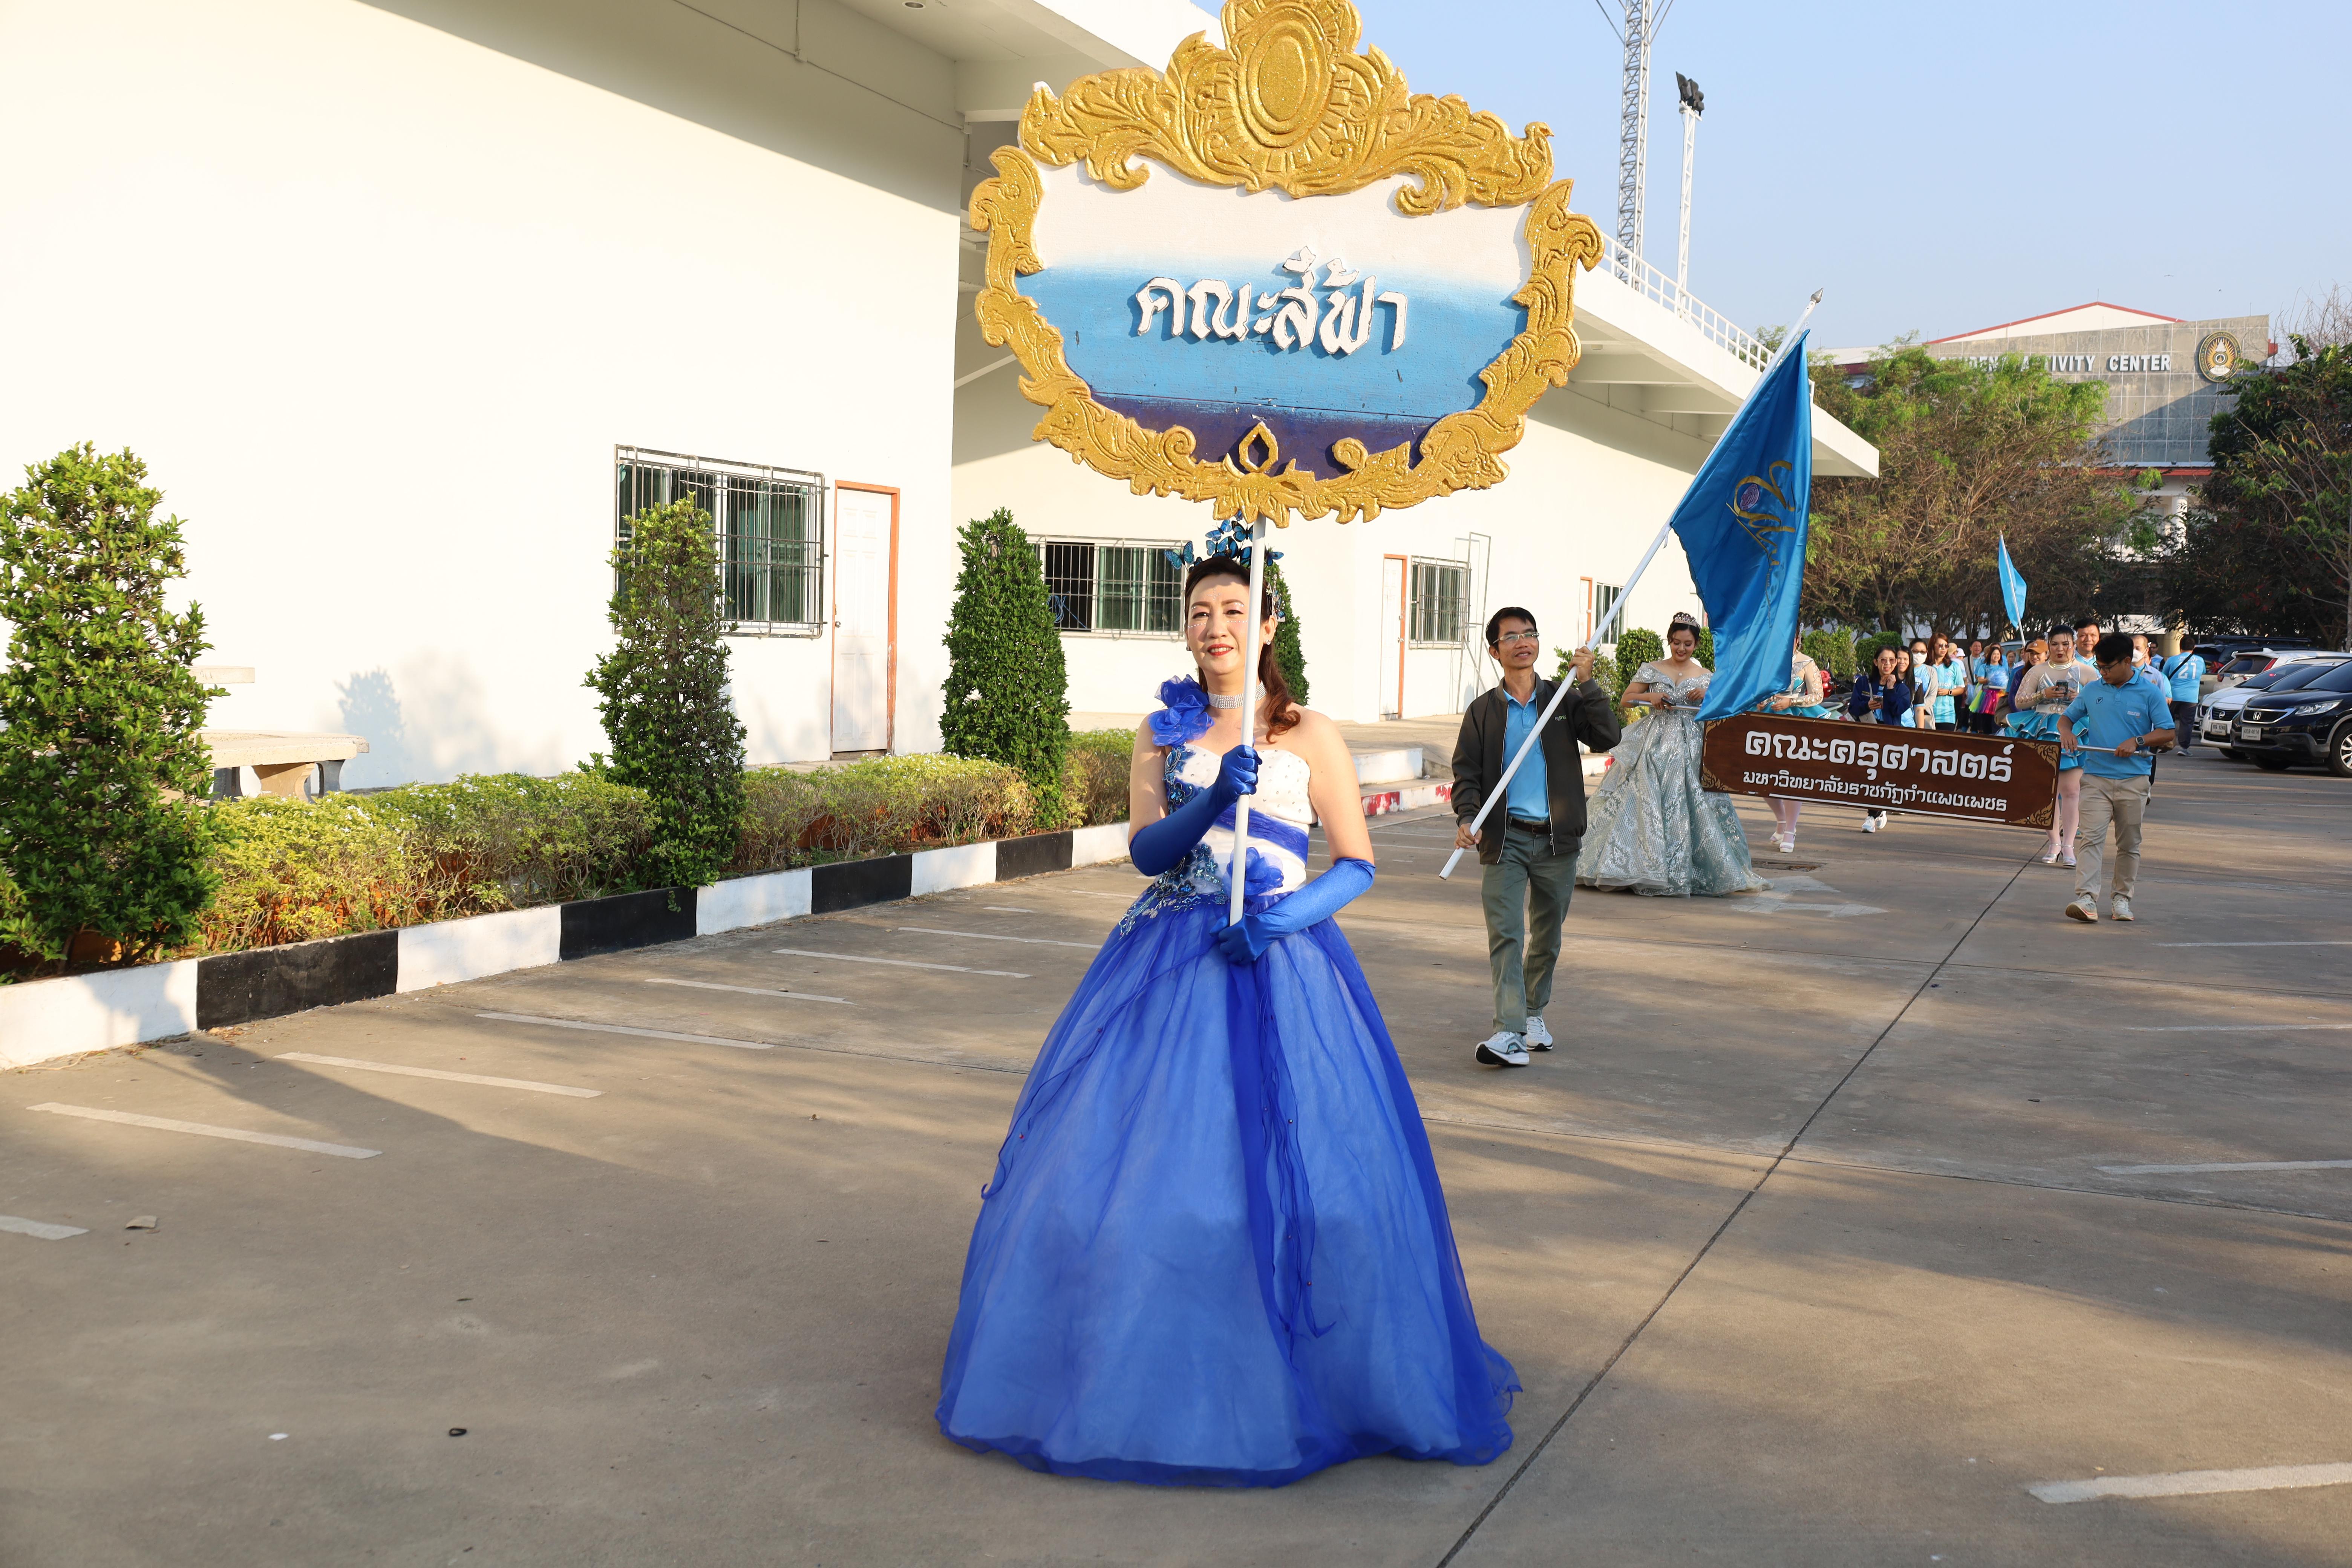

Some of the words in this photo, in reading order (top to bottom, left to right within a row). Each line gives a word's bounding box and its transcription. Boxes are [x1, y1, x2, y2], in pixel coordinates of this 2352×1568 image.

[1136, 245, 1408, 355] คณะสีฟ้า
[2109, 354, 2170, 372] CENTER
[2178, 661, 2196, 679] 21
[1745, 730, 2015, 783] คณะครุศาสตร์
